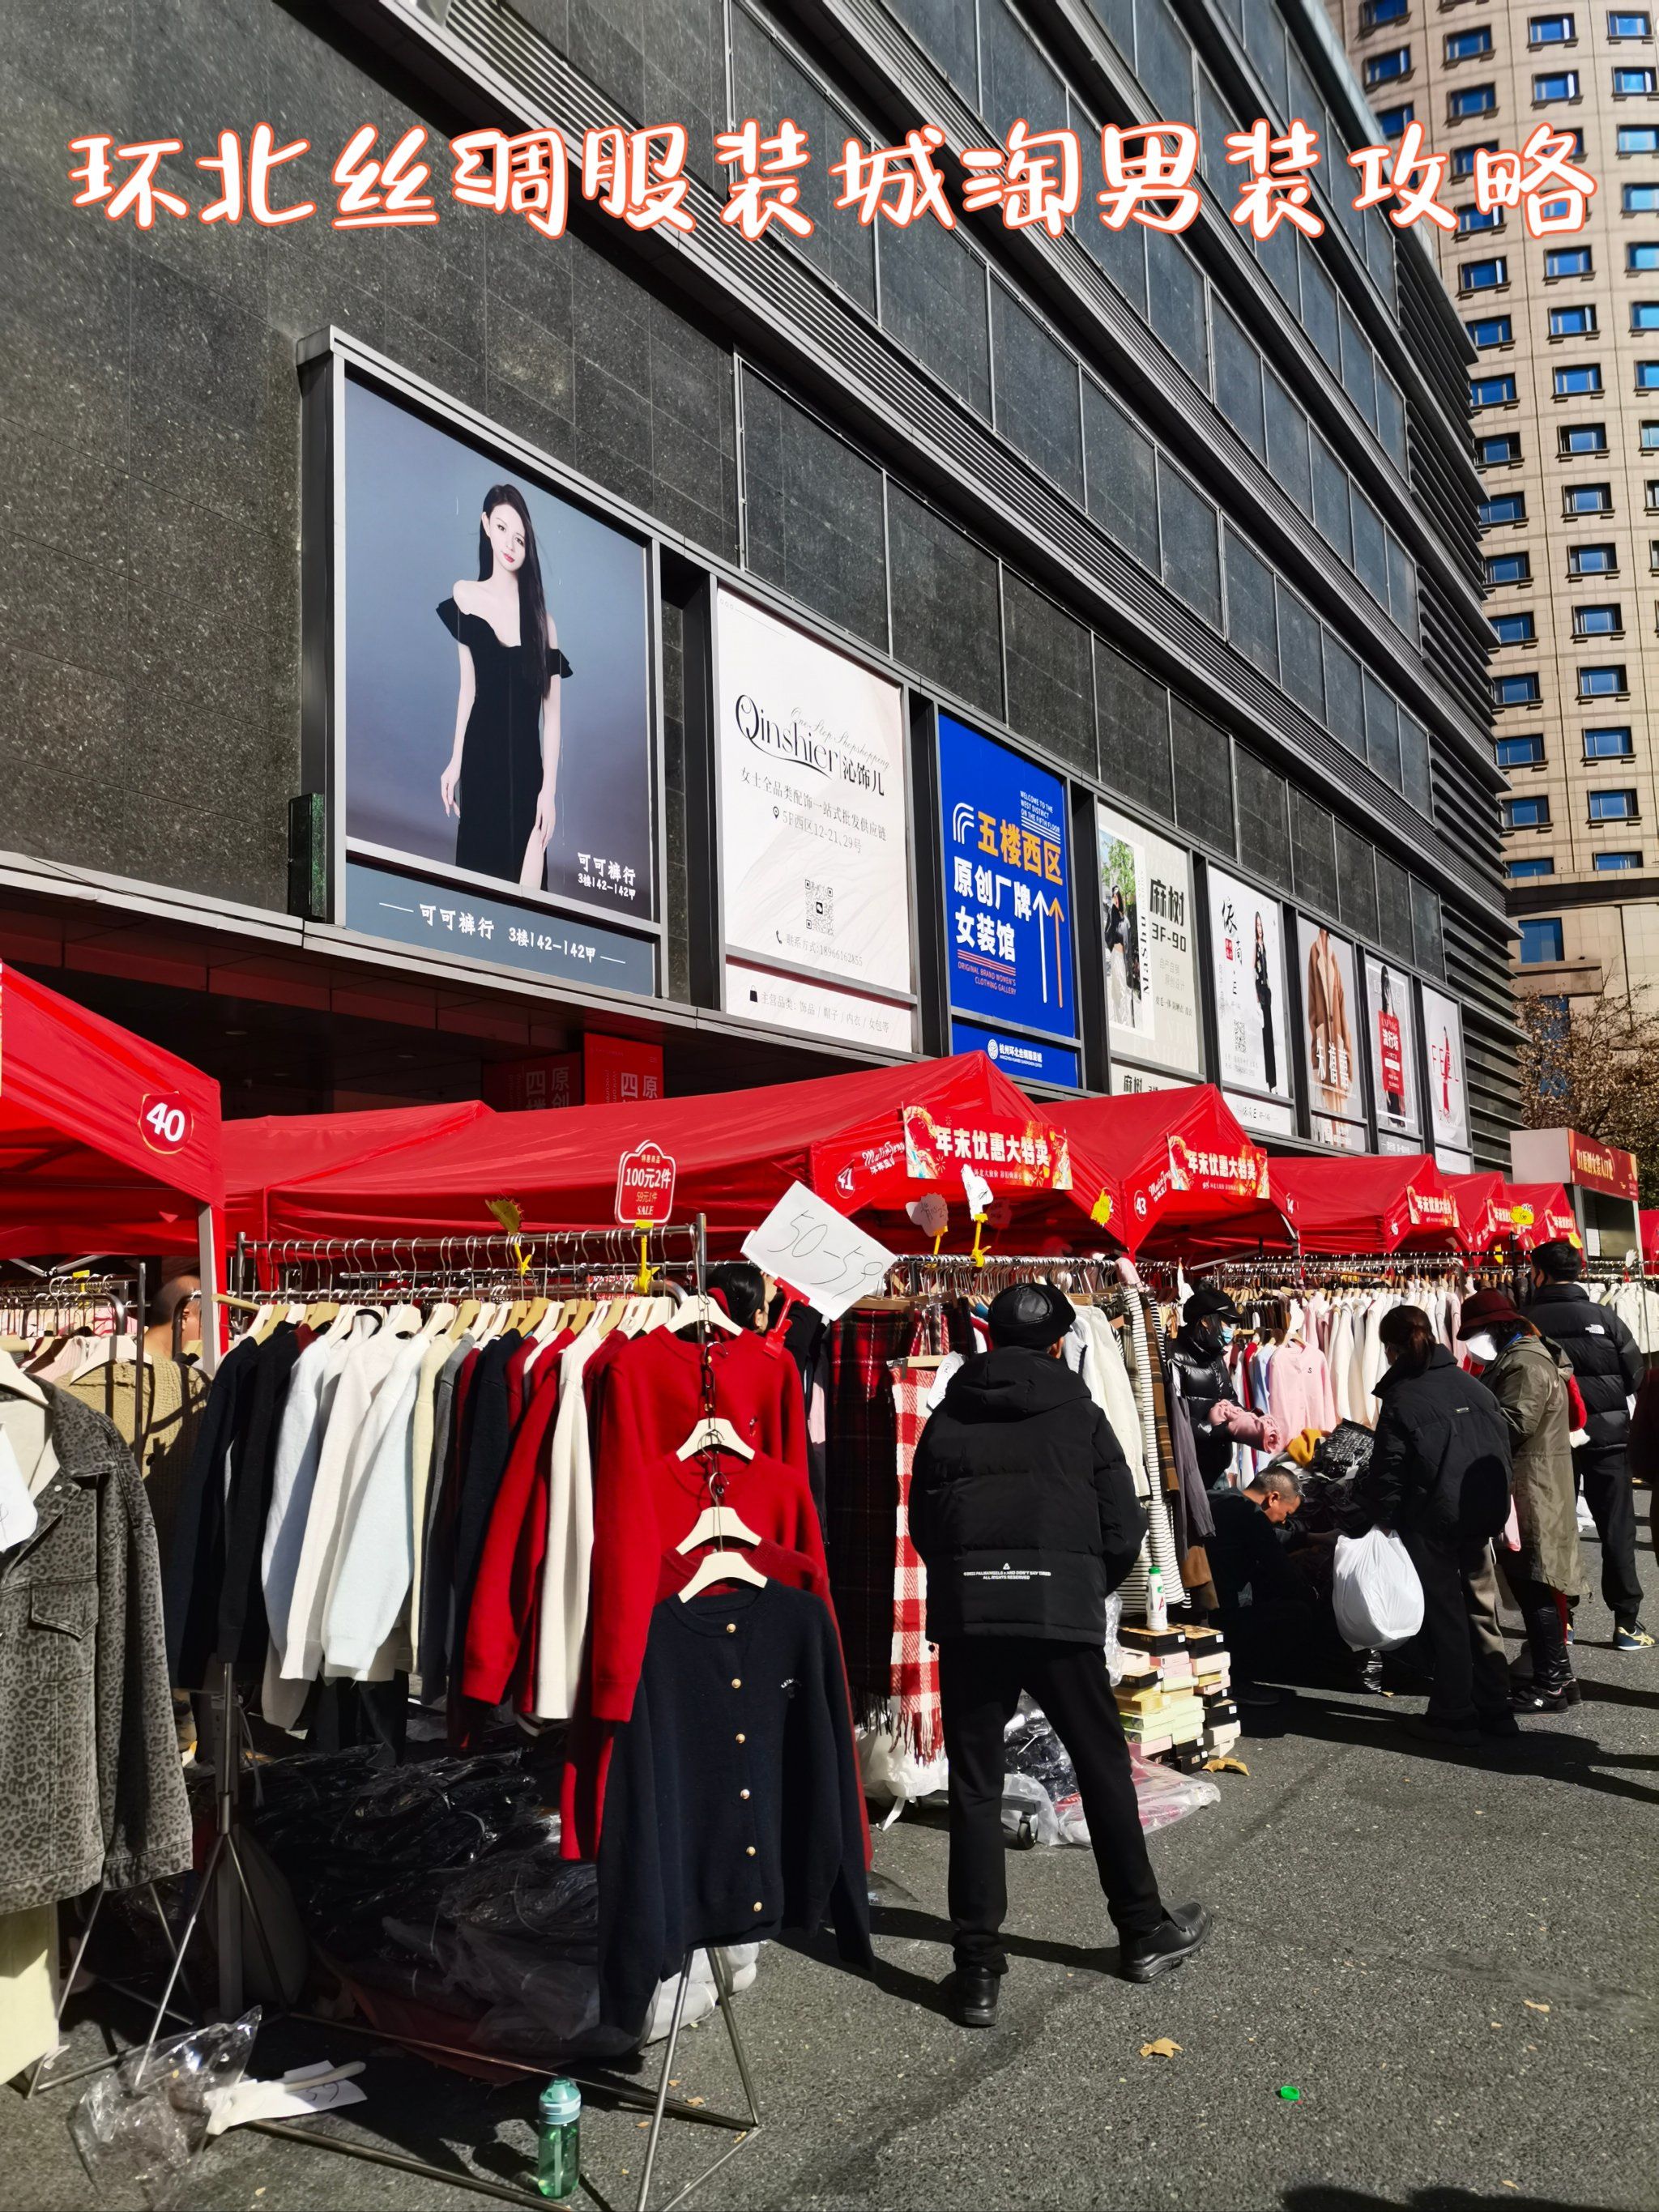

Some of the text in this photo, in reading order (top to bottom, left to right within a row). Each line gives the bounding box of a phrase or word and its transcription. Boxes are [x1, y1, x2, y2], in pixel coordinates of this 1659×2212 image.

[736, 694, 885, 796] Qinshier 沁饰儿
[740, 766, 888, 842] 女士全品类配饰一站式批发供应链
[1020, 791, 1039, 806] WELCOME
[1040, 800, 1045, 809] TO
[1021, 799, 1049, 819] WEST DISTRICT
[1021, 808, 1026, 816] ON
[1036, 816, 1047, 827] FIFTH
[1047, 822, 1060, 833] FLOOR
[978, 811, 1063, 885] 五楼西区
[577, 851, 636, 886] 可可裤行
[578, 872, 636, 901] 3楼142-142甲
[953, 856, 1032, 922] 原创厂牌
[1150, 879, 1184, 927] 麻树
[419, 903, 596, 963] 可可裤行 3楼142-142甲
[955, 906, 1016, 962] 女装馆
[1151, 923, 1187, 953] 3F-90
[957, 961, 1016, 986] ORIGINAL BRAND WOMEN'S
[975, 977, 1016, 995] CLOTHING GALLERY
[146, 1102, 186, 1143] 40
[935, 1125, 1050, 1167] 年末优惠大特卖
[625, 1168, 672, 1189] 100元2件
[838, 1167, 854, 1191] 41
[1188, 1151, 1256, 1181] 年末优惠大特卖
[636, 1205, 654, 1215] SALE
[1136, 1197, 1146, 1215] 43
[767, 1208, 884, 1301] 50-59
